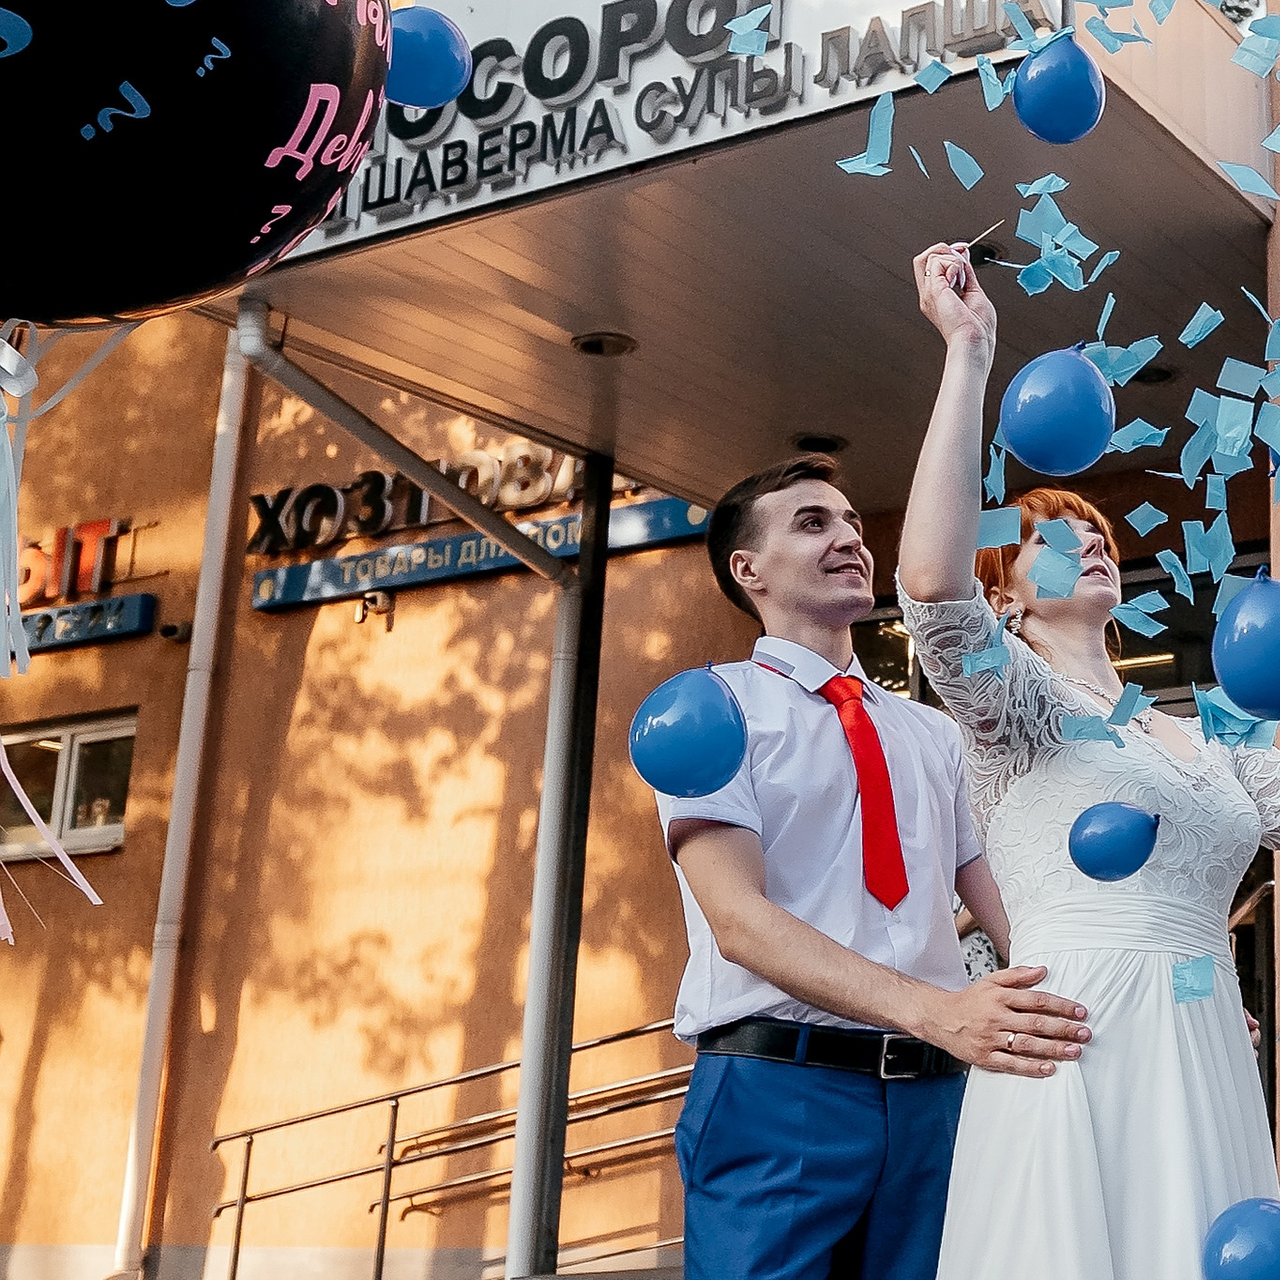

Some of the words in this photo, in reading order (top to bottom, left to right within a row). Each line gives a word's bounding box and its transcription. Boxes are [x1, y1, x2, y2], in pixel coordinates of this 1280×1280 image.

[361, 97, 618, 213] ШАВЕРМА
[635, 41, 800, 137] СУПЫ
[339, 543, 451, 585] ТОВАРЫ
